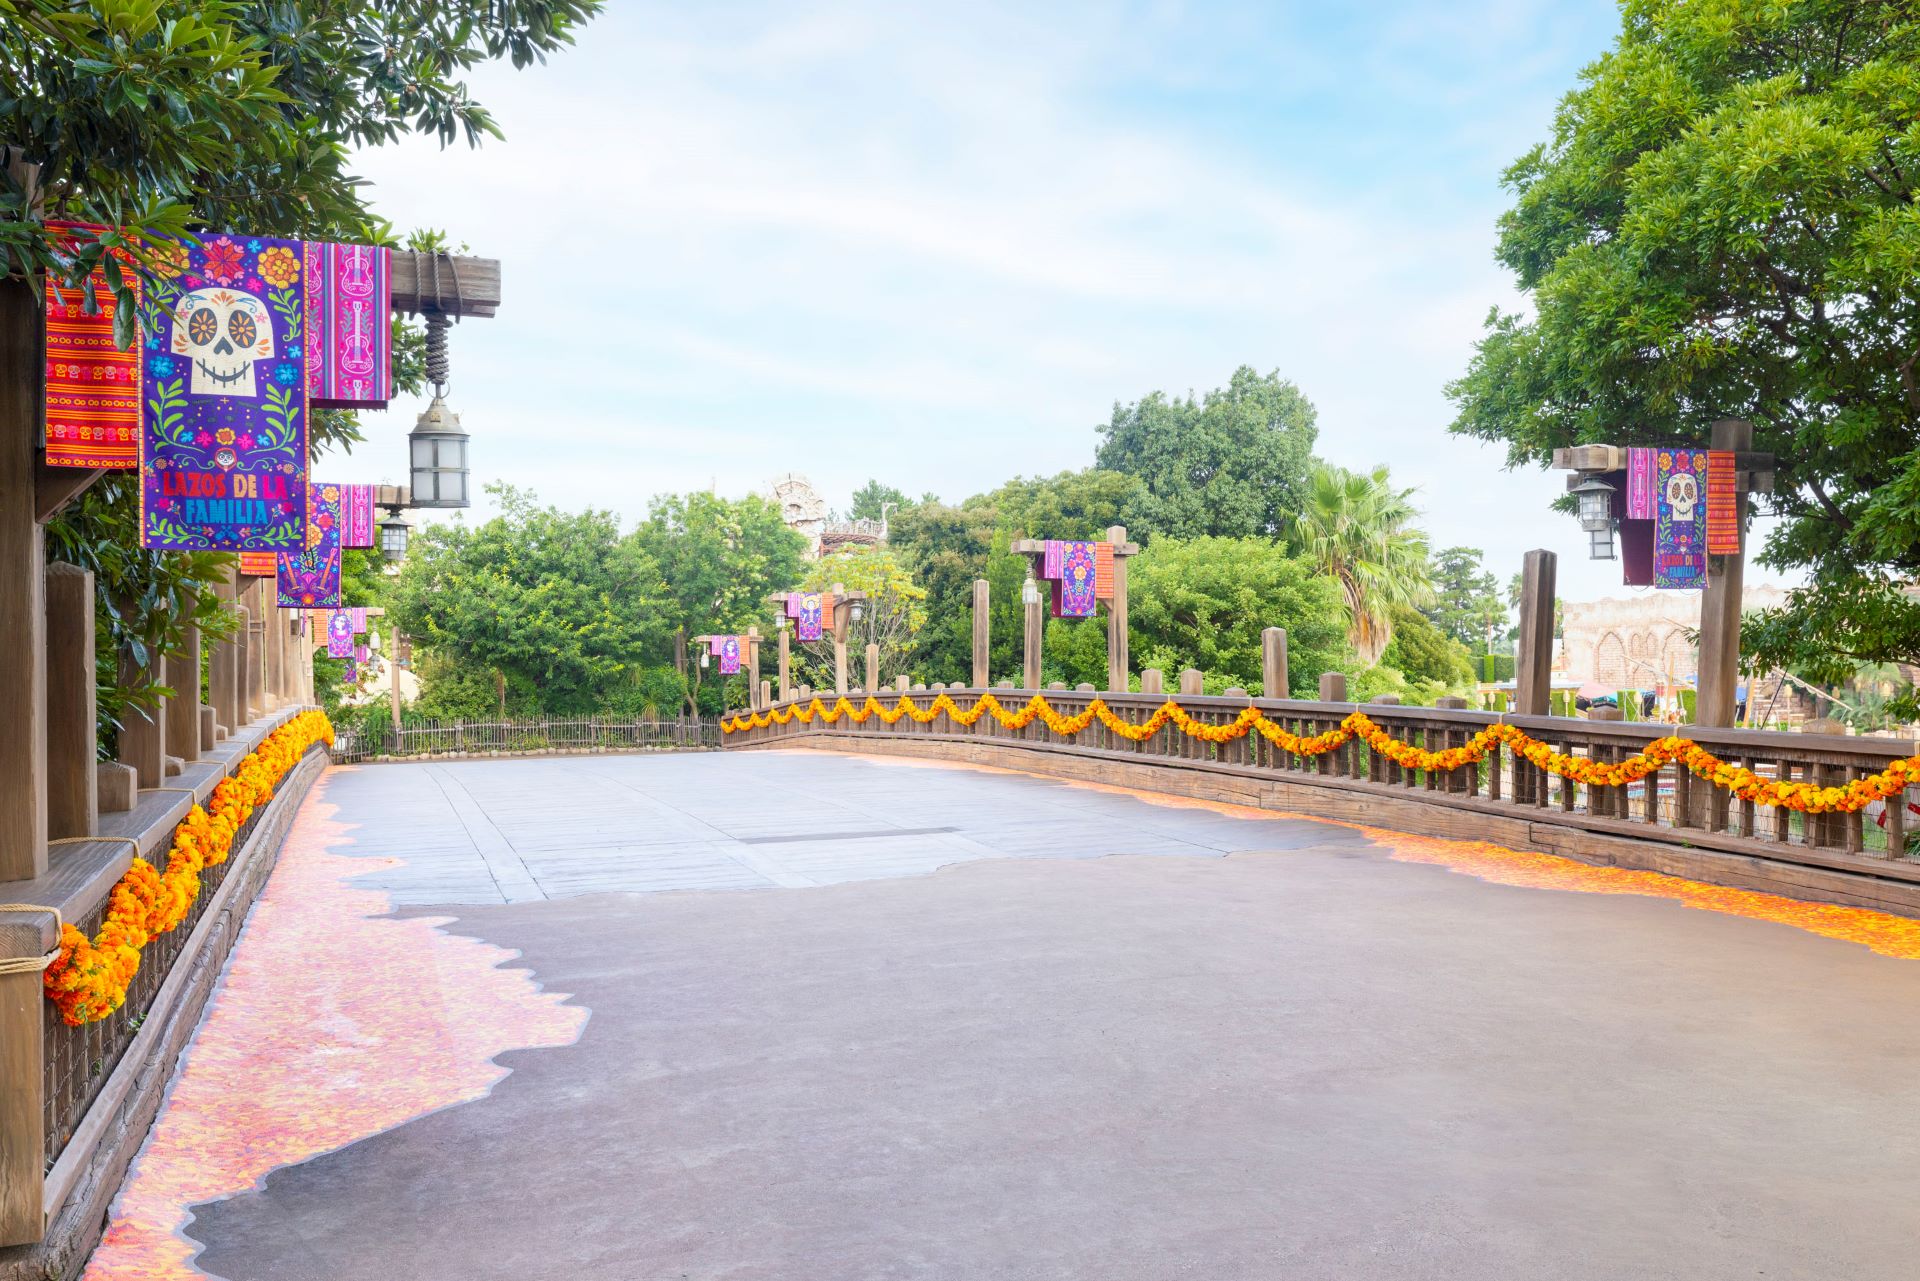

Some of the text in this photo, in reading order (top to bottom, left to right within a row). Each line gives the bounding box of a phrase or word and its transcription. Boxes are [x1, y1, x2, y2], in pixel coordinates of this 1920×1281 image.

[163, 472, 288, 500] LAZOS DE LA
[186, 499, 268, 524] FAMILIA
